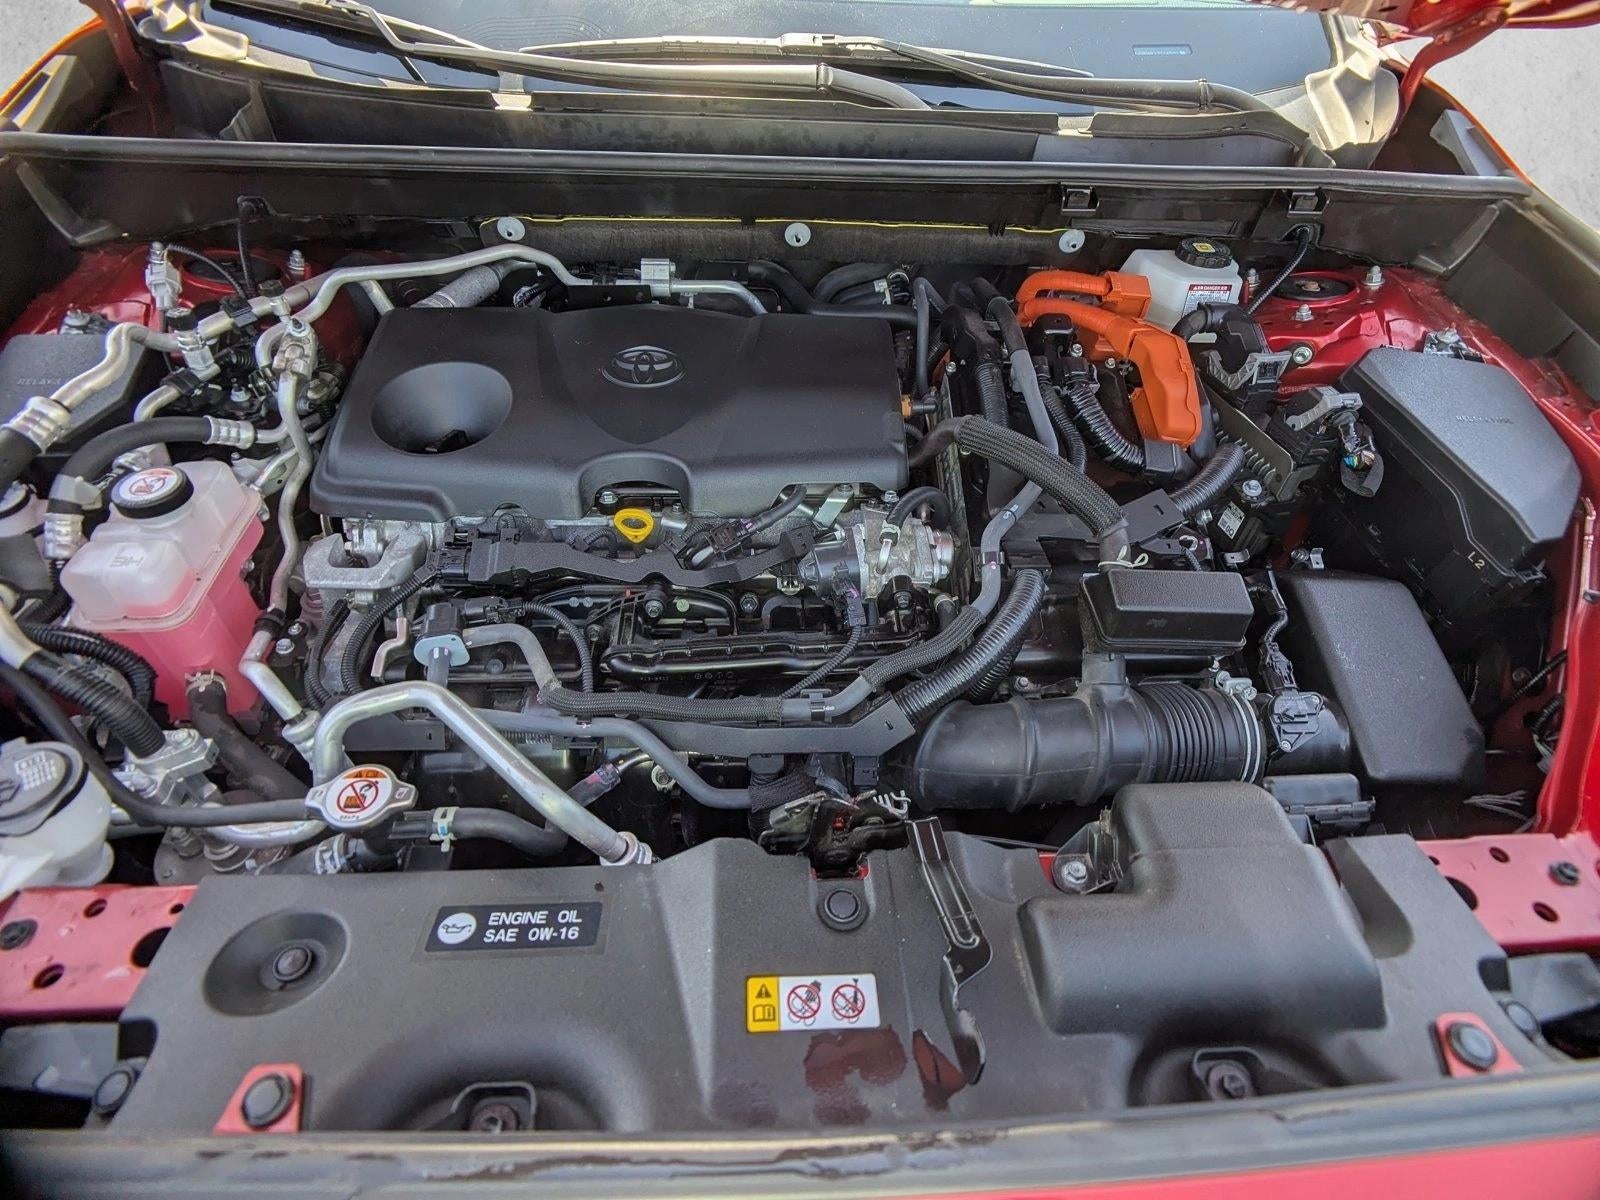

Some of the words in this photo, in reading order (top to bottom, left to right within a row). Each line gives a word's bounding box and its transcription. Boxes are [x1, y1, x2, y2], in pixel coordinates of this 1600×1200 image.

[1467, 551, 1485, 570] L2
[488, 911, 549, 926] ENGINE
[557, 910, 582, 924] OIL
[483, 928, 519, 943] SAE
[528, 926, 580, 941] 0W-16
